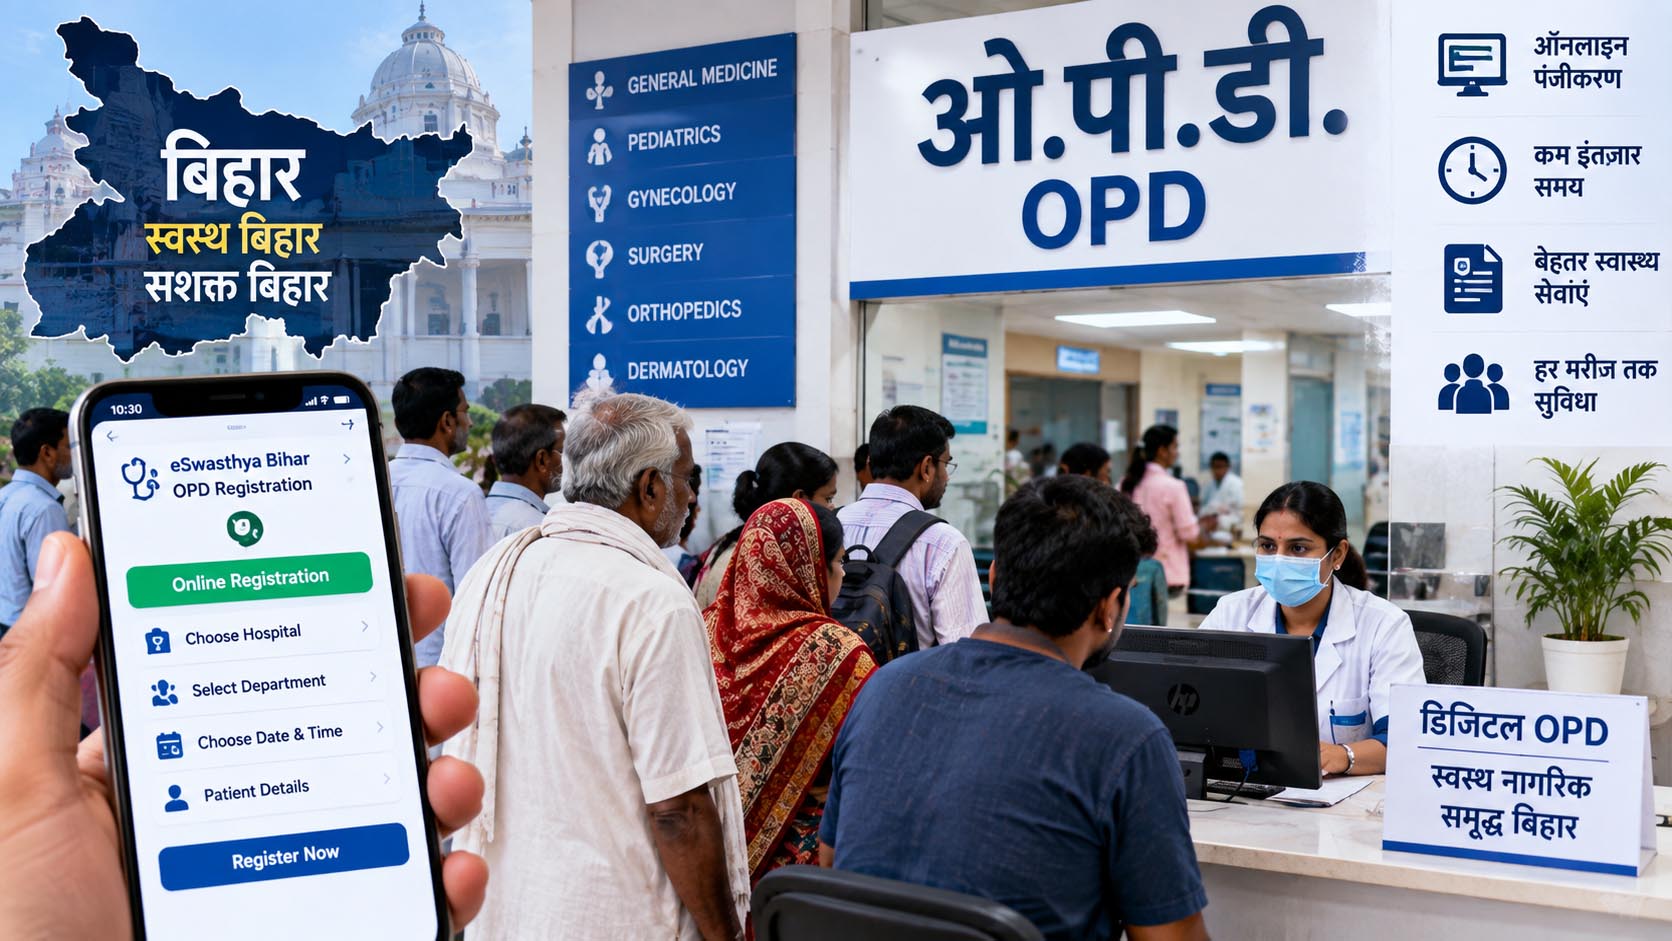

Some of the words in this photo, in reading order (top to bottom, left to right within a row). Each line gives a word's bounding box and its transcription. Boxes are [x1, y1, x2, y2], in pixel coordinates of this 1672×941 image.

[1533, 31, 1629, 59] ऑनलाइन
[628, 69, 697, 95] GENERAL
[701, 58, 777, 85] MEDICINE
[917, 5, 1348, 167] ओ.पी.डी.
[1533, 63, 1622, 88] पंजीकरण
[628, 124, 720, 152] PEDIATRICS
[1533, 146, 1571, 165] कम
[1576, 140, 1642, 169] इंतज़ार
[627, 181, 736, 209] GYNECOLOGY
[1533, 178, 1584, 197] समय
[1021, 170, 1206, 250] OPD
[628, 242, 703, 266] SURGERY
[1533, 246, 1589, 274] बेहतर
[1593, 253, 1660, 271] स्वास्थ्य
[627, 299, 741, 323] ORTHOPEDICS
[628, 358, 748, 380] DERMATOLOGY
[1533, 361, 1559, 382] हर
[1621, 361, 1658, 379] तक
[110, 403, 142, 415] 10:30
[1533, 386, 1597, 419] सुविधा
[170, 453, 261, 473] eSwasthya
[266, 451, 309, 468] Bihar
[173, 482, 209, 499] OPD
[214, 477, 312, 499] Registration
[172, 574, 225, 593] Online
[230, 568, 329, 591] Registration
[185, 631, 239, 646] Choose
[243, 623, 301, 642] Hospital
[192, 681, 237, 698] Select
[241, 674, 326, 695] Department
[1169, 683, 1199, 715] hp
[1419, 700, 1525, 741] डिजिटल
[1534, 715, 1608, 746] OPD
[197, 735, 251, 750] Choose
[255, 730, 289, 745] Date
[293, 727, 304, 741] &
[307, 725, 342, 740] Time
[204, 785, 256, 802] Patient
[259, 779, 309, 797] Details
[1430, 765, 1494, 791] स्वस्थ
[1500, 766, 1592, 798] नागरिक
[1511, 803, 1579, 840] बिहार
[231, 850, 299, 871] Register
[303, 845, 339, 862] Now
